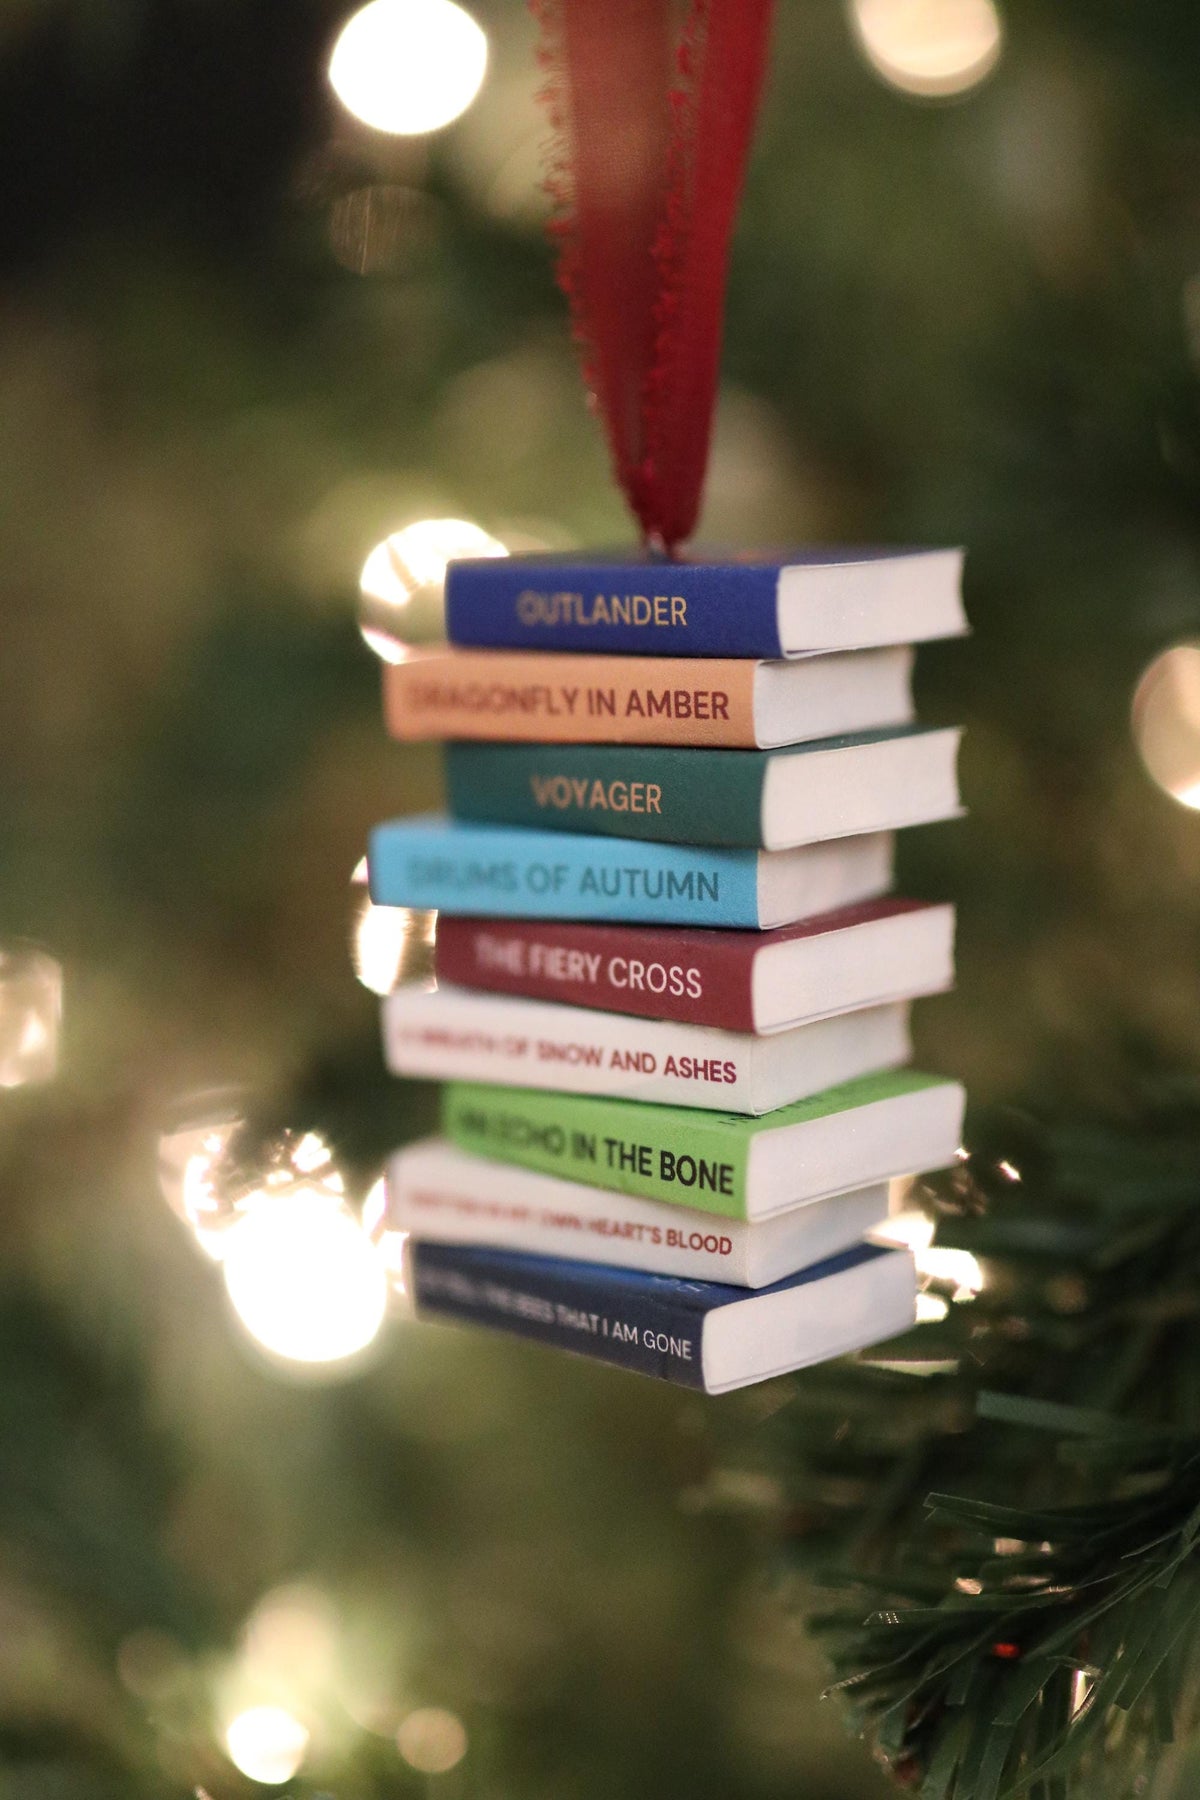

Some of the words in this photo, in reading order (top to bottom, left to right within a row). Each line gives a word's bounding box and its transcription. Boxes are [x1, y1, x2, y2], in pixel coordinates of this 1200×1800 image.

[518, 589, 688, 627] OUTLANDER
[588, 687, 616, 718] IN
[625, 689, 730, 721] AMBER
[531, 775, 663, 815] VOYAGER
[526, 863, 571, 895] OF
[579, 867, 720, 902] AUTUMN
[529, 943, 601, 985] FIERY
[608, 956, 703, 1000] CROSS
[538, 1040, 604, 1069] SNOW
[610, 1050, 657, 1075] AND
[663, 1055, 738, 1086] ASHES
[571, 1133, 597, 1164] IN
[603, 1137, 654, 1178] THE
[660, 1150, 735, 1196] BONE
[588, 1219, 663, 1246] HEART'S
[666, 1228, 733, 1257] BLOOD
[556, 1305, 599, 1336] THAT
[602, 1316, 609, 1337] I
[612, 1320, 639, 1346] AM
[643, 1330, 693, 1362] GONE
